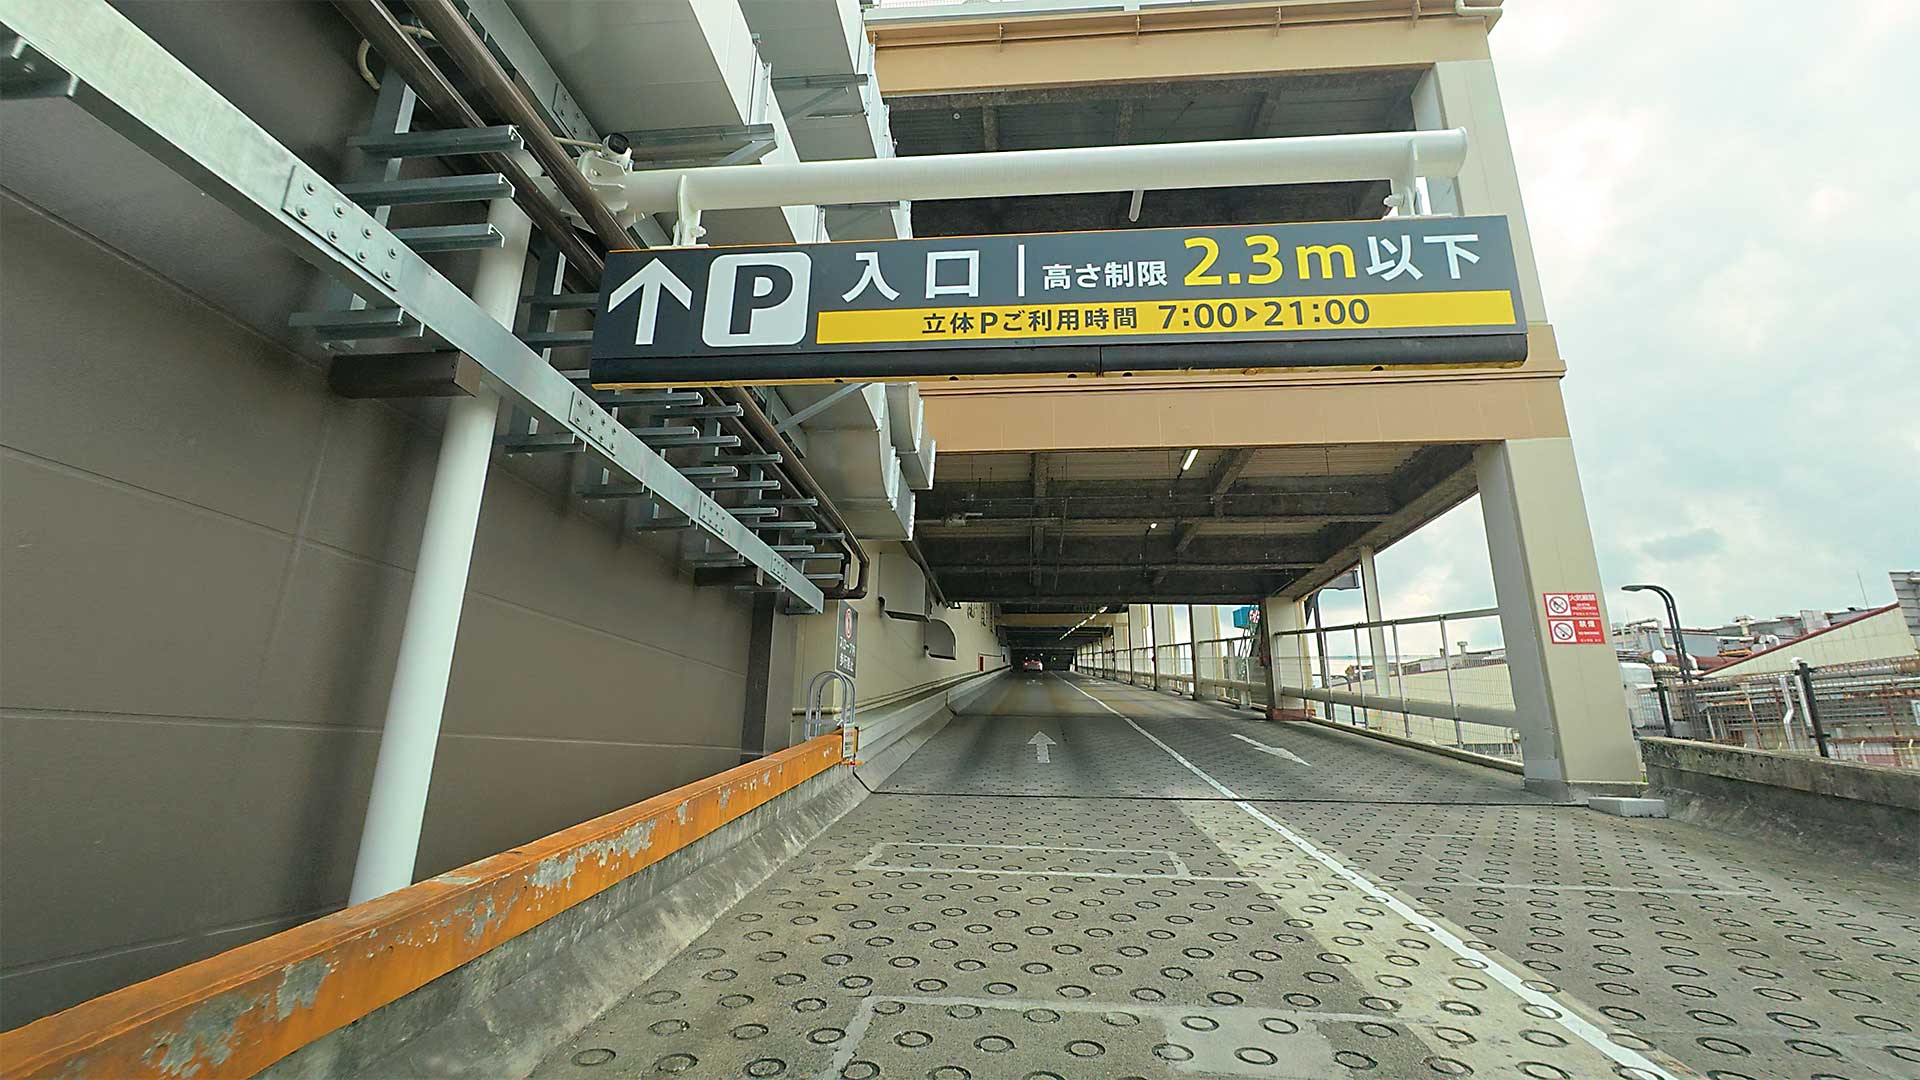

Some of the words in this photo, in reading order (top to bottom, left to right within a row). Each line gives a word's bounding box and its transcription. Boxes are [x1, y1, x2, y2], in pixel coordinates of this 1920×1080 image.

[729, 264, 793, 335] P
[841, 250, 980, 303] 入口
[1042, 260, 1169, 290] 高さ制限
[921, 307, 1138, 334] 立体Pご利用時間
